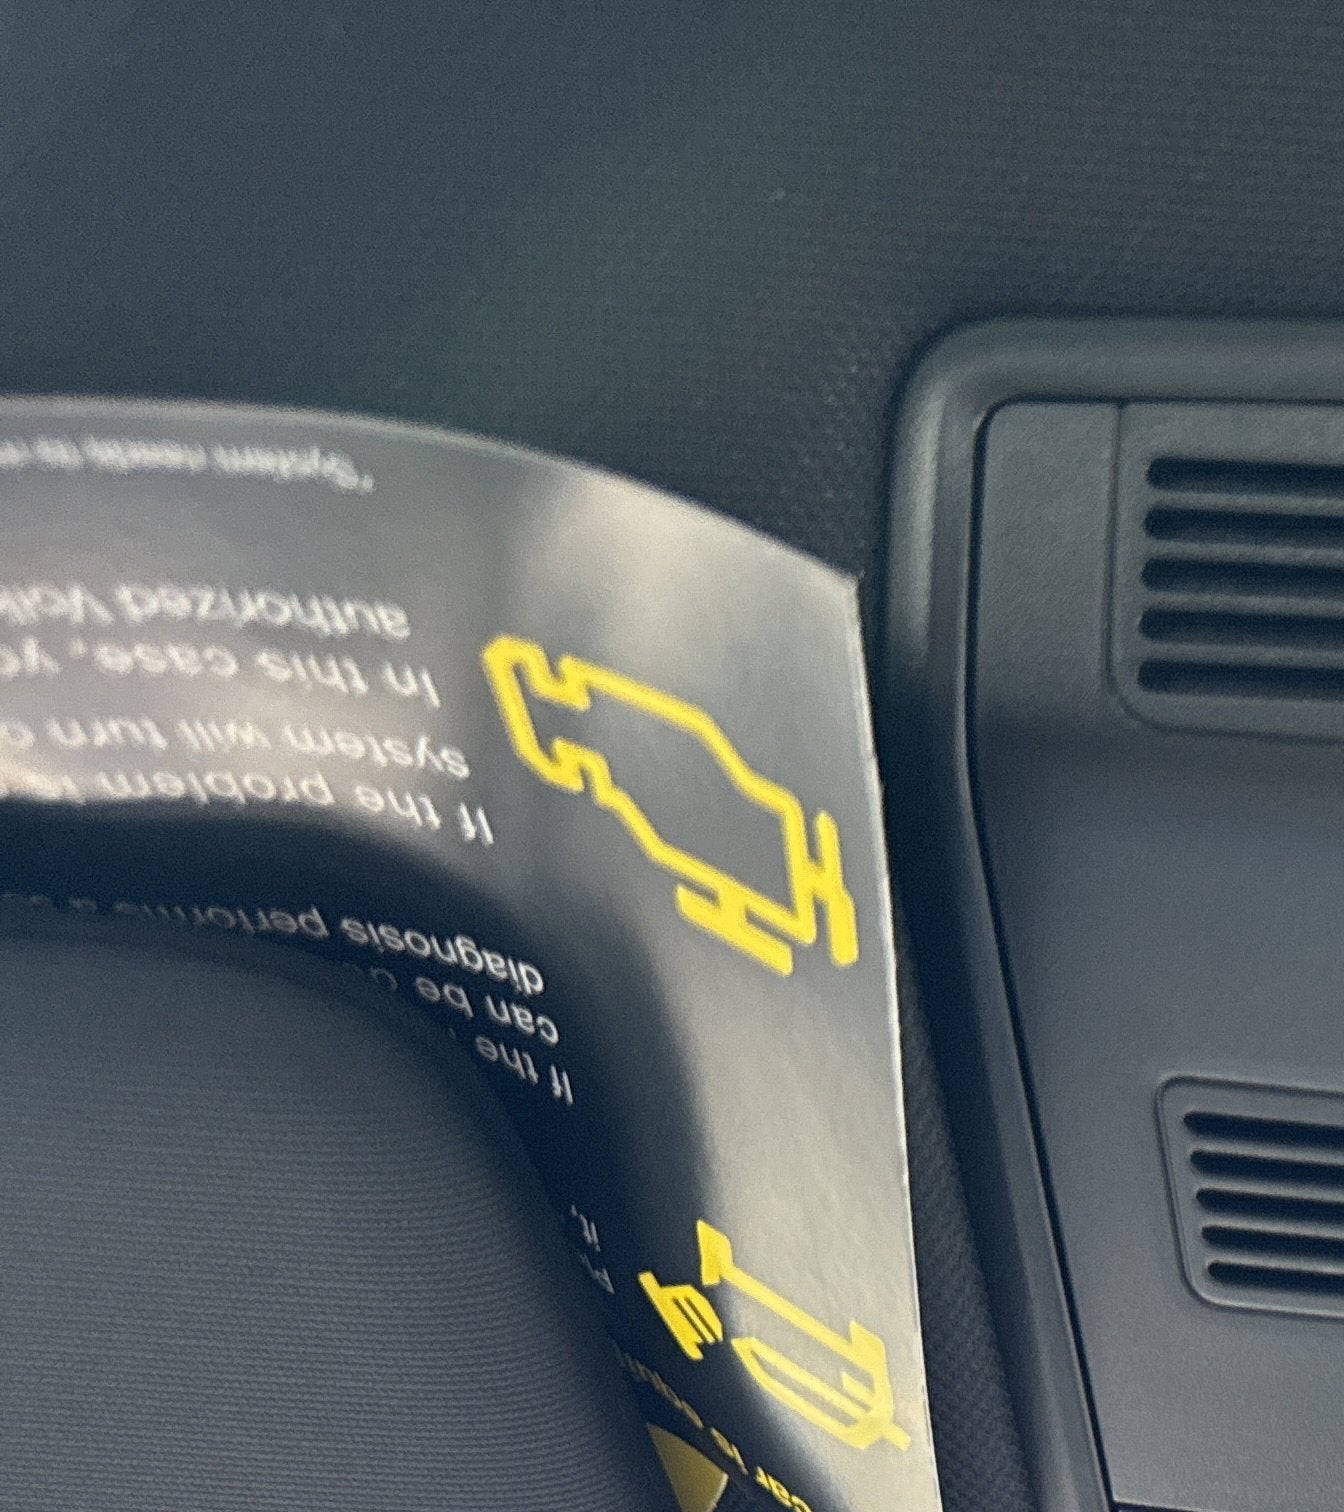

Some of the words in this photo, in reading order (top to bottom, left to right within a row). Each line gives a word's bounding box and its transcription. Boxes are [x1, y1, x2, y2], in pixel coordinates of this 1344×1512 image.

[113, 582, 411, 640] authorized
[254, 646, 370, 696] this
[380, 660, 442, 711] In
[46, 718, 169, 751] turn
[174, 717, 274, 754] will
[280, 723, 472, 780] system
[98, 768, 336, 807] problem
[354, 779, 442, 831] the
[457, 802, 495, 847] If
[340, 913, 546, 997] diagnosis
[415, 973, 475, 1019] be
[484, 990, 560, 1046] can
[475, 1032, 540, 1086] the
[550, 1061, 575, 1107] If
